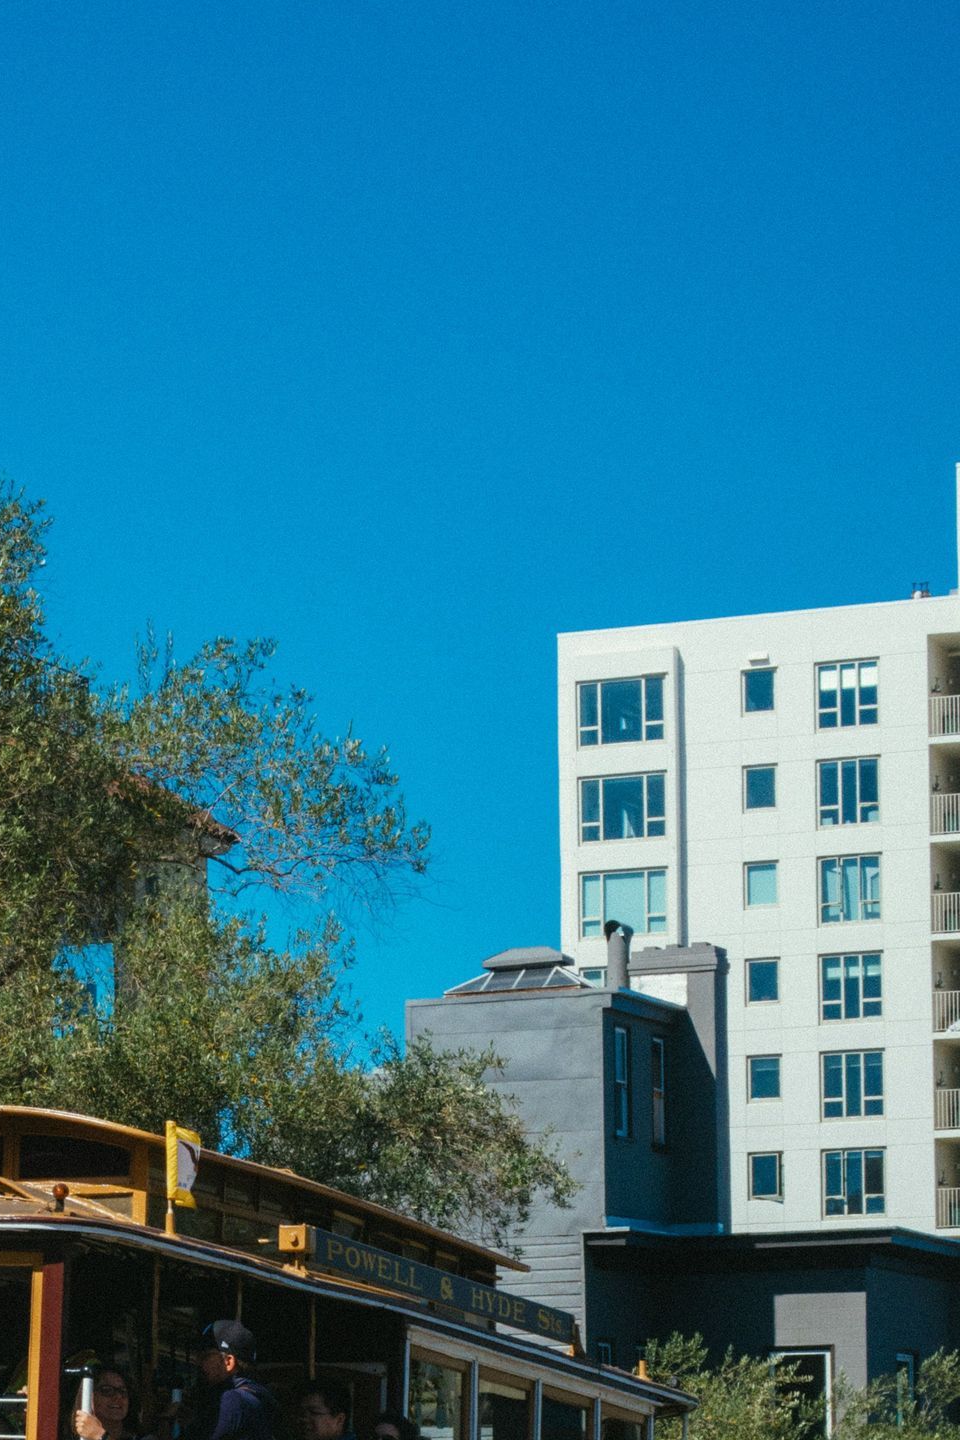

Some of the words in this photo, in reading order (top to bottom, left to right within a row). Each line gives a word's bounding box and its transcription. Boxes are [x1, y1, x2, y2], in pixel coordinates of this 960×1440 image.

[326, 1239, 423, 1291] POWELL
[439, 1276, 455, 1301] &
[471, 1287, 526, 1323] HYDE
